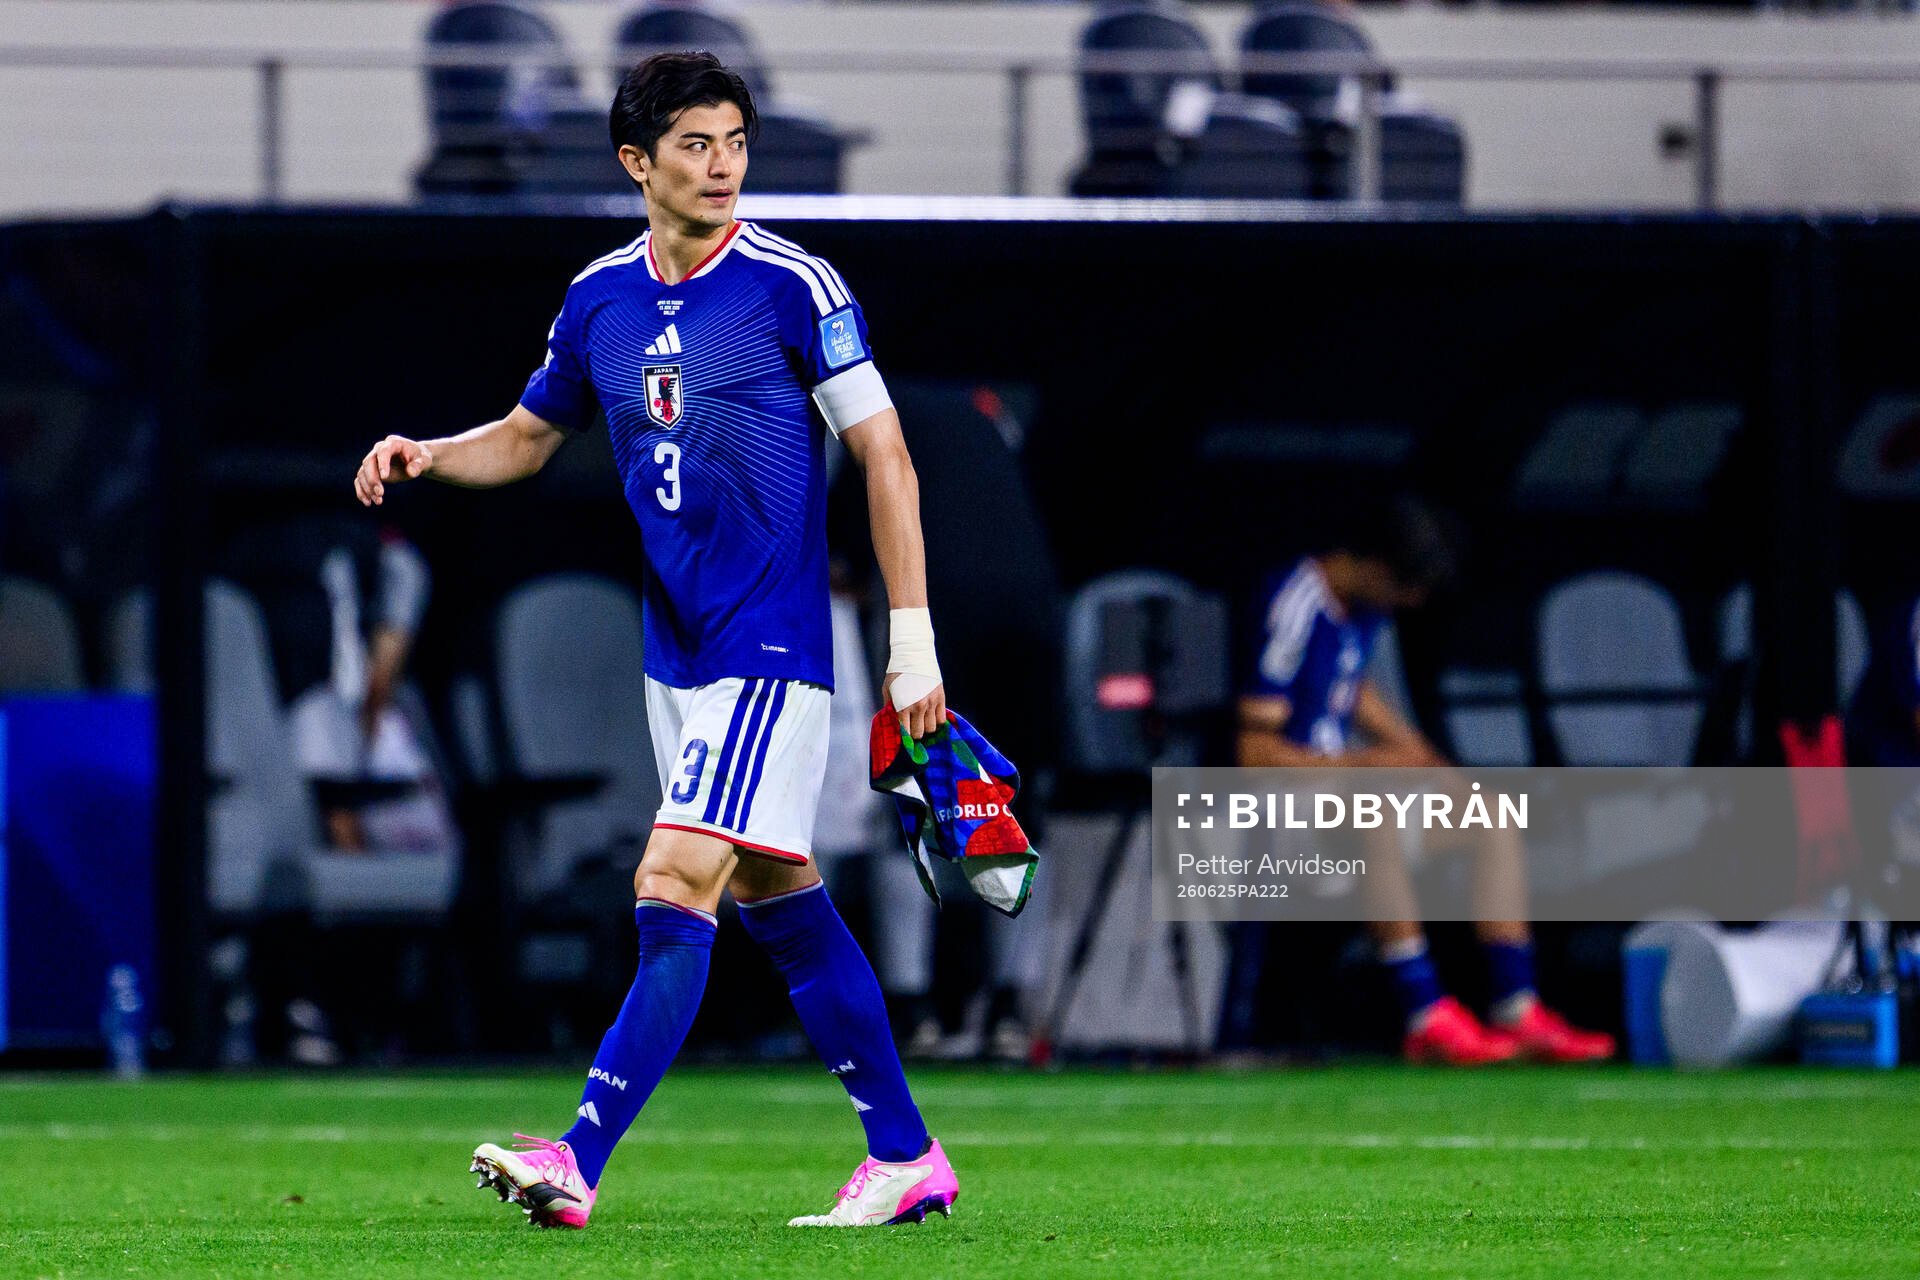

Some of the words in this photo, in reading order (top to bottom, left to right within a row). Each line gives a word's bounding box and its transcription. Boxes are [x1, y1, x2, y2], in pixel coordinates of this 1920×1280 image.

[654, 442, 681, 511] 3
[671, 738, 709, 805] 3
[953, 803, 1000, 818] ORLD
